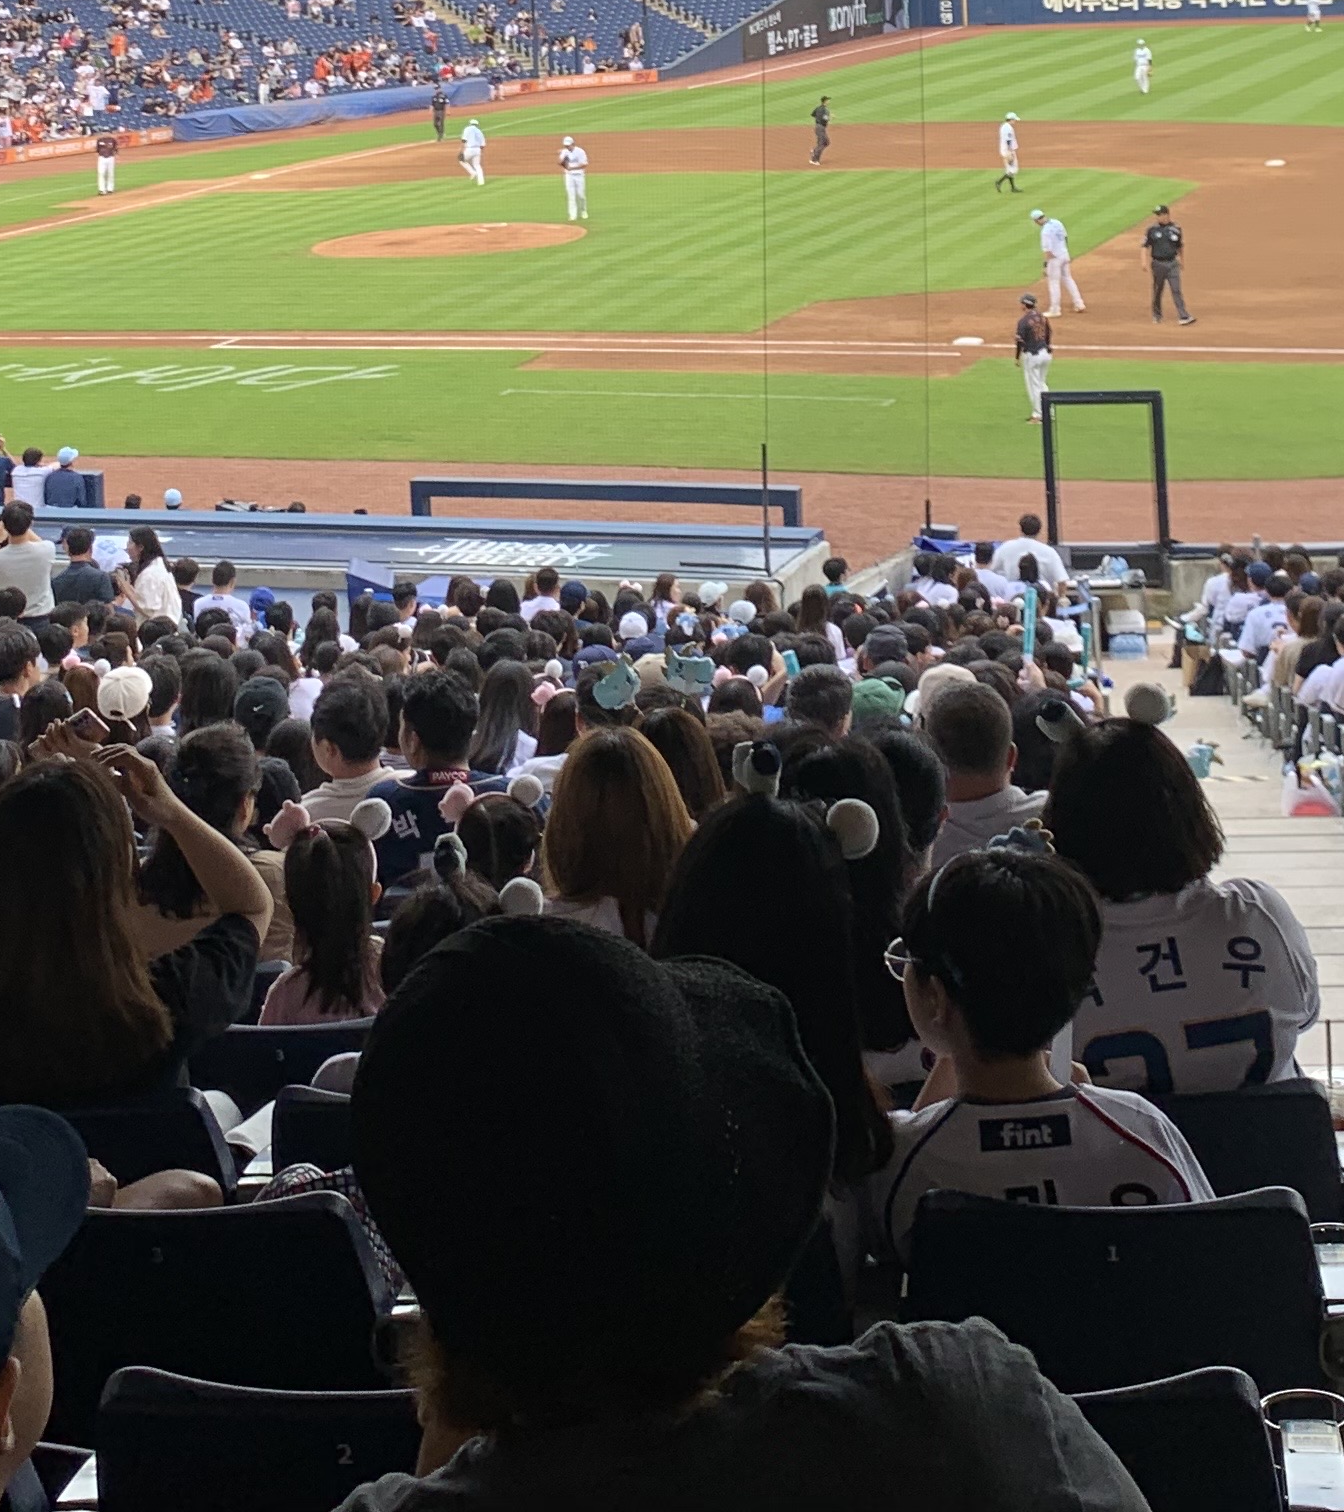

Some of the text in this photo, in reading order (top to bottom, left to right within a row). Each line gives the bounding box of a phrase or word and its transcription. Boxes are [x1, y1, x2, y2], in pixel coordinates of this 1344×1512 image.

[422, 768, 454, 780] PAYCO
[999, 1122, 1054, 1146] fint
[1108, 1246, 1120, 1261] 1
[336, 1444, 354, 1465] 2
